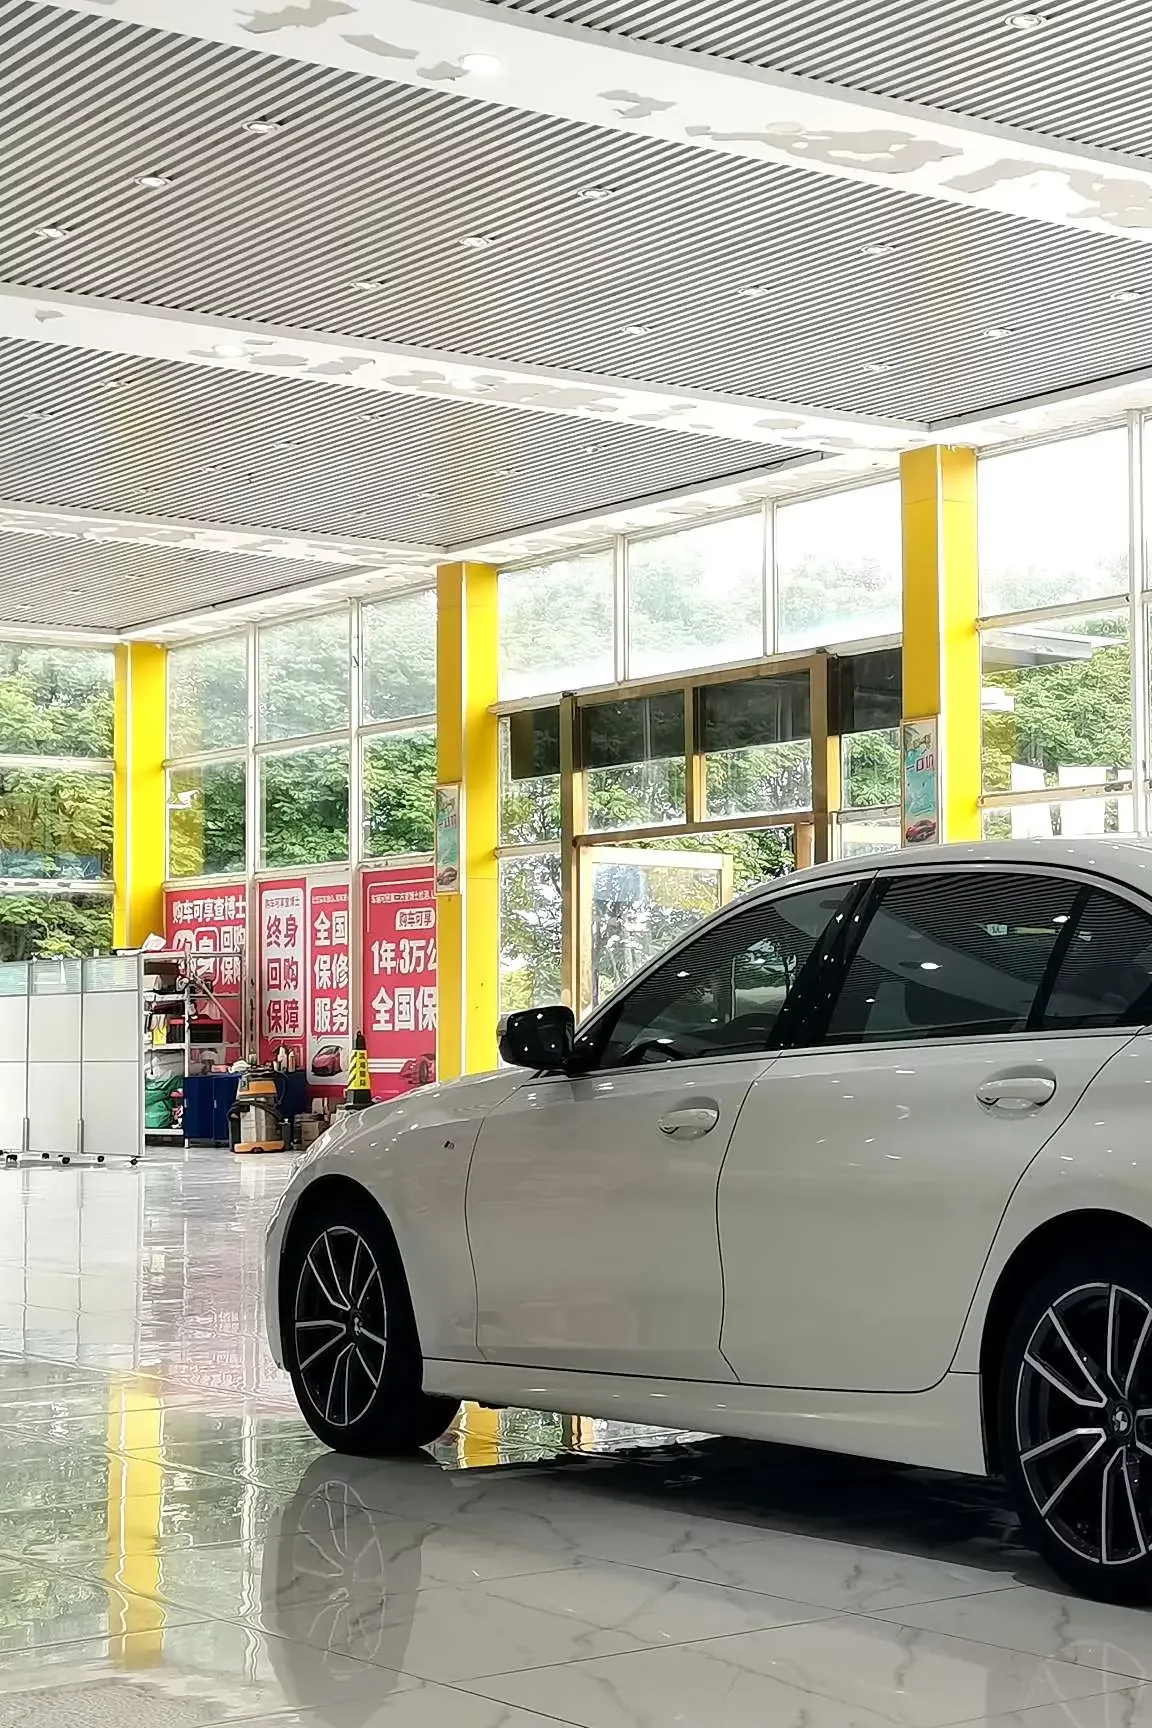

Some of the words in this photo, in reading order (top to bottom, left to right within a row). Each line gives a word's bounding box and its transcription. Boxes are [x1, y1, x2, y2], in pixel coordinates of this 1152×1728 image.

[172, 894, 246, 924] 购车可享查博士
[399, 909, 432, 928] 购车可享
[266, 913, 298, 948] 终身
[313, 911, 348, 946] 全国
[266, 957, 299, 991] 回购
[313, 953, 348, 990] 保修
[266, 999, 299, 1034] 保障
[314, 998, 348, 1033] 服务
[371, 987, 437, 1032] 全国保
